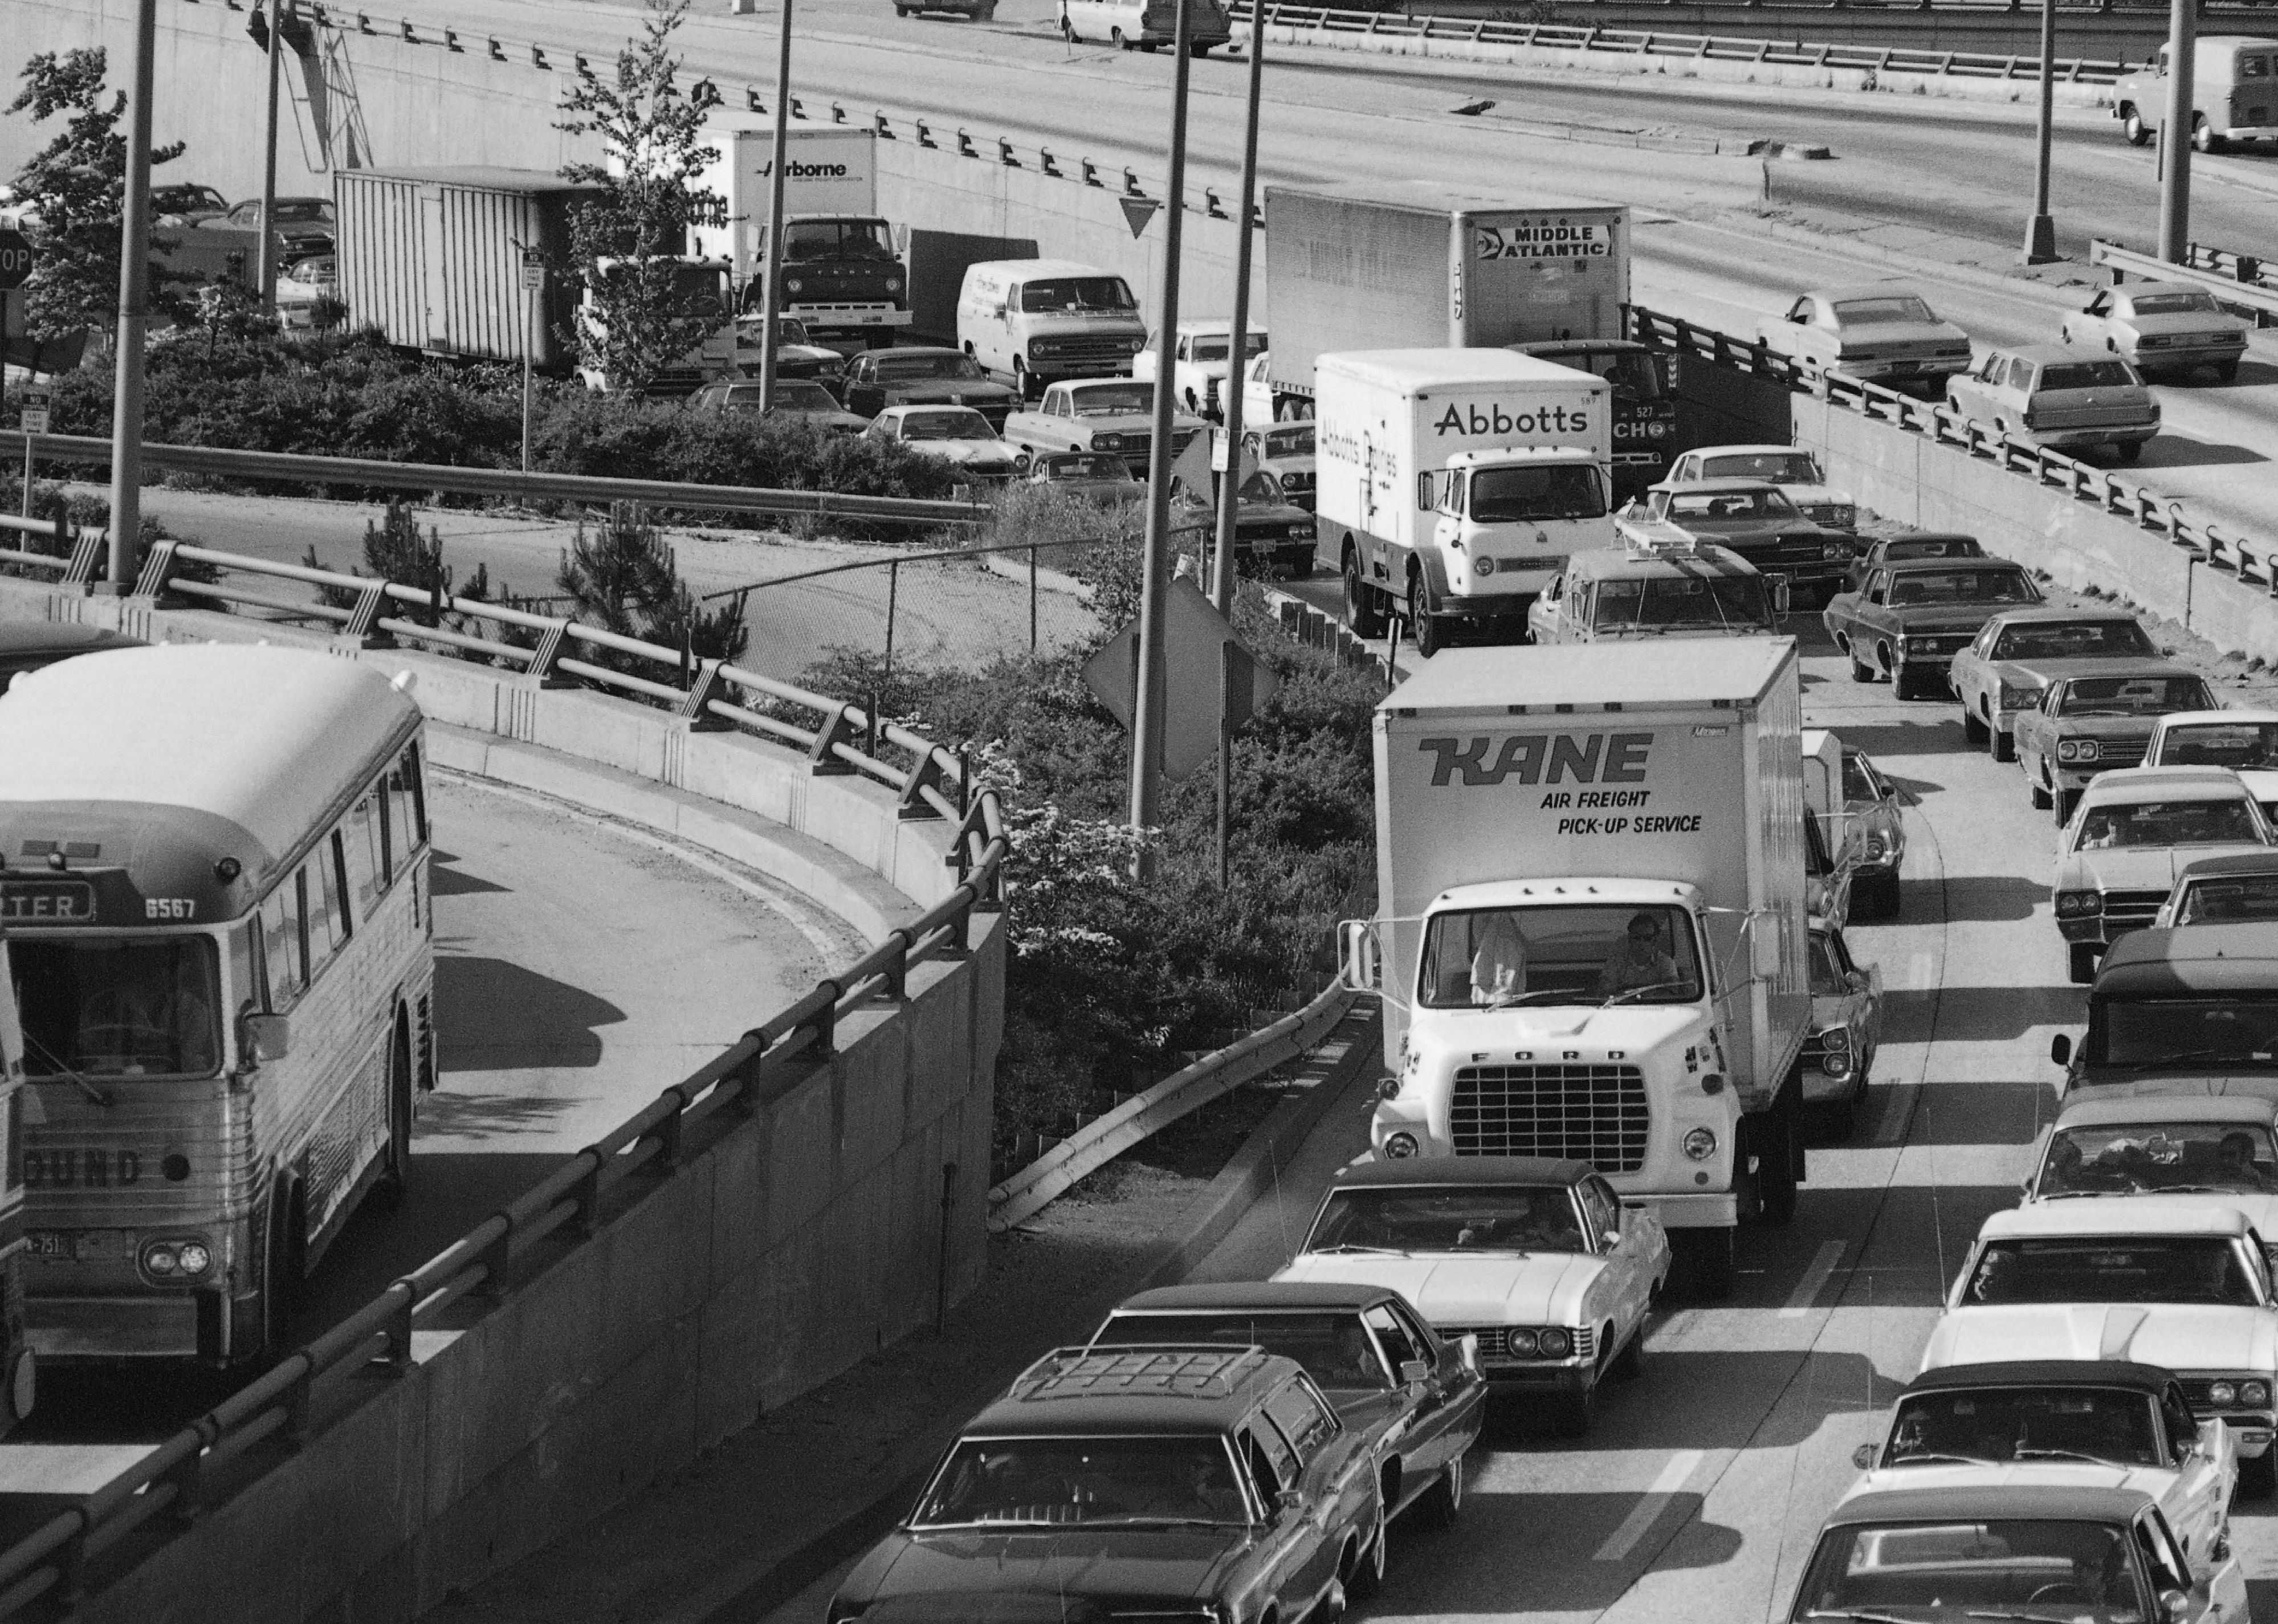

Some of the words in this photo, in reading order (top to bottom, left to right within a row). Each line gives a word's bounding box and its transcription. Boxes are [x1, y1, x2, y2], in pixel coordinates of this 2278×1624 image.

[1514, 227, 1594, 242] MIDDLE
[0, 248, 28, 271] OP
[1505, 243, 1604, 258] ATLANTIC
[1433, 402, 1588, 436] Abbotts
[1637, 407, 1653, 418] 527
[1418, 733, 1654, 786] KANE
[1540, 792, 1571, 809] AIR
[1576, 790, 1651, 808] FREIGHT
[1558, 817, 1628, 834] PICK-UP
[1633, 814, 1702, 833] SERVICE
[0, 896, 73, 918] TER
[145, 898, 195, 918] 6567
[1472, 1051, 1625, 1062] FORD
